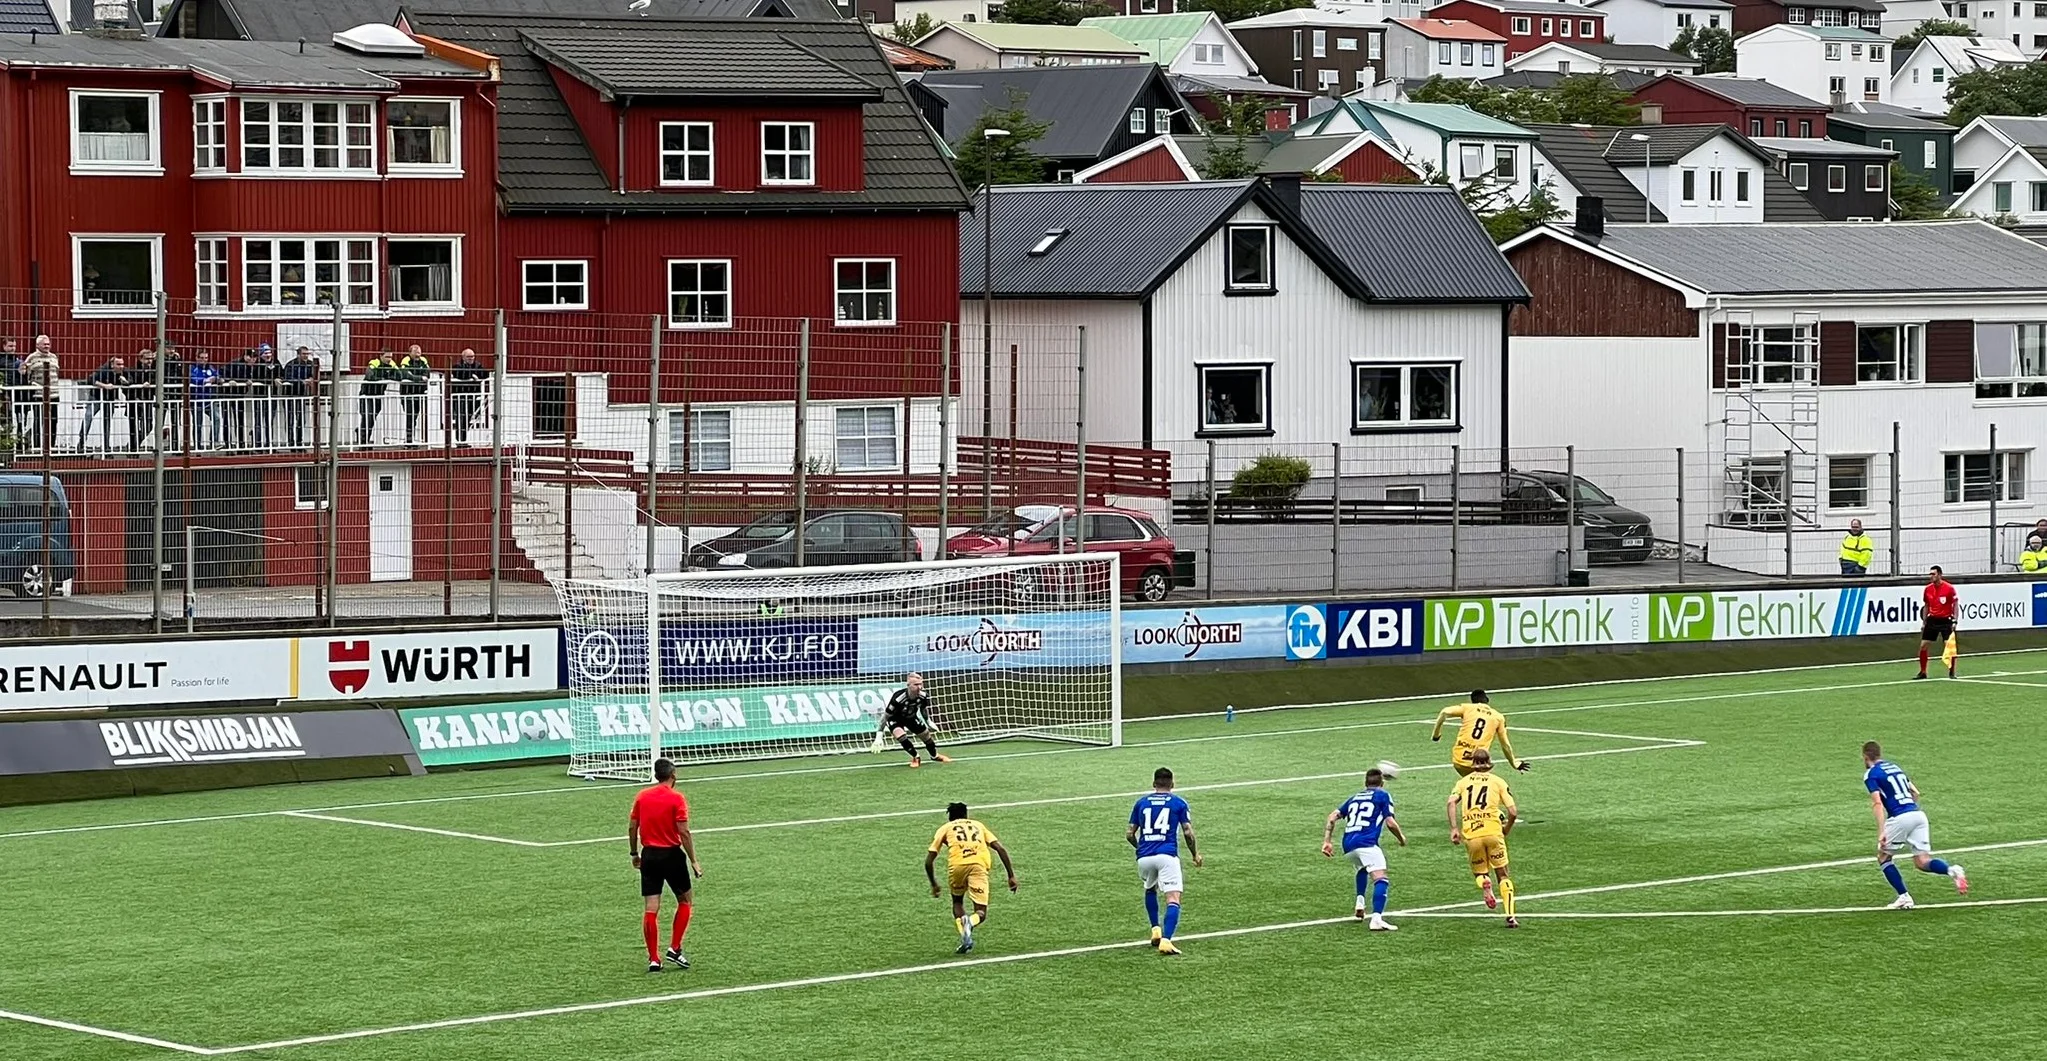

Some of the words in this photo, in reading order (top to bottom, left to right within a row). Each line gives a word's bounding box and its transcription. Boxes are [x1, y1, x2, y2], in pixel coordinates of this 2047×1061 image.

[1434, 602, 1485, 646] MP
[1499, 598, 1614, 644] Teknik
[1659, 595, 1705, 639] MP
[1718, 592, 1826, 637] Teknik
[1959, 601, 2025, 620] YGGIVIRKI
[927, 635, 970, 652] LOOK
[981, 631, 1041, 652] NORTH
[1135, 628, 1176, 645] LOOK
[1186, 624, 1241, 644] NORTH
[1338, 607, 1412, 649] KBI
[381, 644, 530, 683] WÜRTH
[675, 635, 838, 665] WWW.KJ.FO
[171, 679, 202, 687] Passion
[204, 677, 215, 686] for
[217, 676, 229, 685] life
[413, 710, 574, 750] KANJON
[1472, 718, 1486, 740] 8
[1466, 785, 1488, 810] 14
[1887, 773, 1913, 800] 10
[1143, 807, 1170, 834] 14
[1346, 801, 1375, 827] 32
